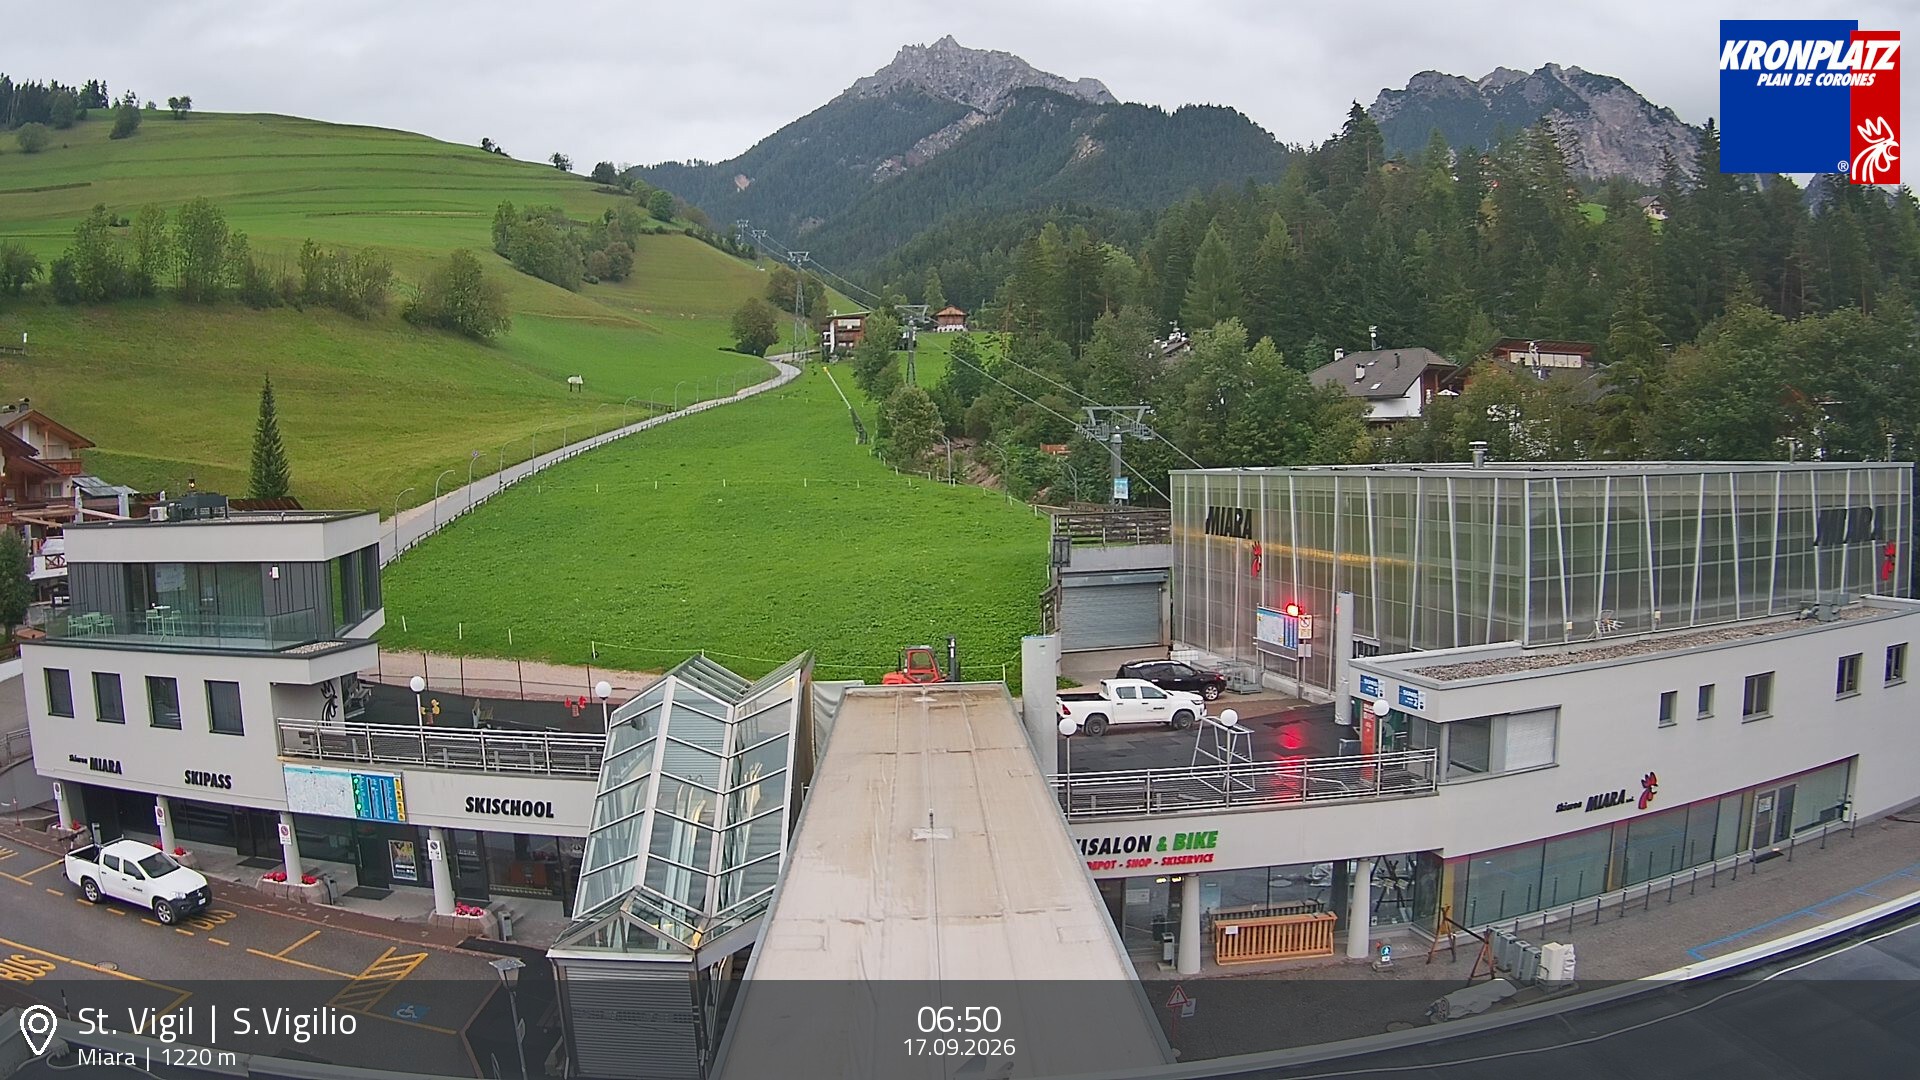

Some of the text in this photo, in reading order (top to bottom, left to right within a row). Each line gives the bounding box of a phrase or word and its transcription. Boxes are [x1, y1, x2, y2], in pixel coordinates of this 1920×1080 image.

[1205, 506, 1253, 540] MIARA
[89, 757, 123, 775] MIARA
[184, 769, 232, 790] SKIPASS
[464, 796, 554, 819] SKISCHOOL
[1585, 789, 1626, 812] MIARA
[1076, 831, 1219, 856] ISALON & BIKE
[1125, 858, 1153, 869] SHOP
[1160, 853, 1214, 866] SKISERVICE
[0, 954, 56, 985] BUS
